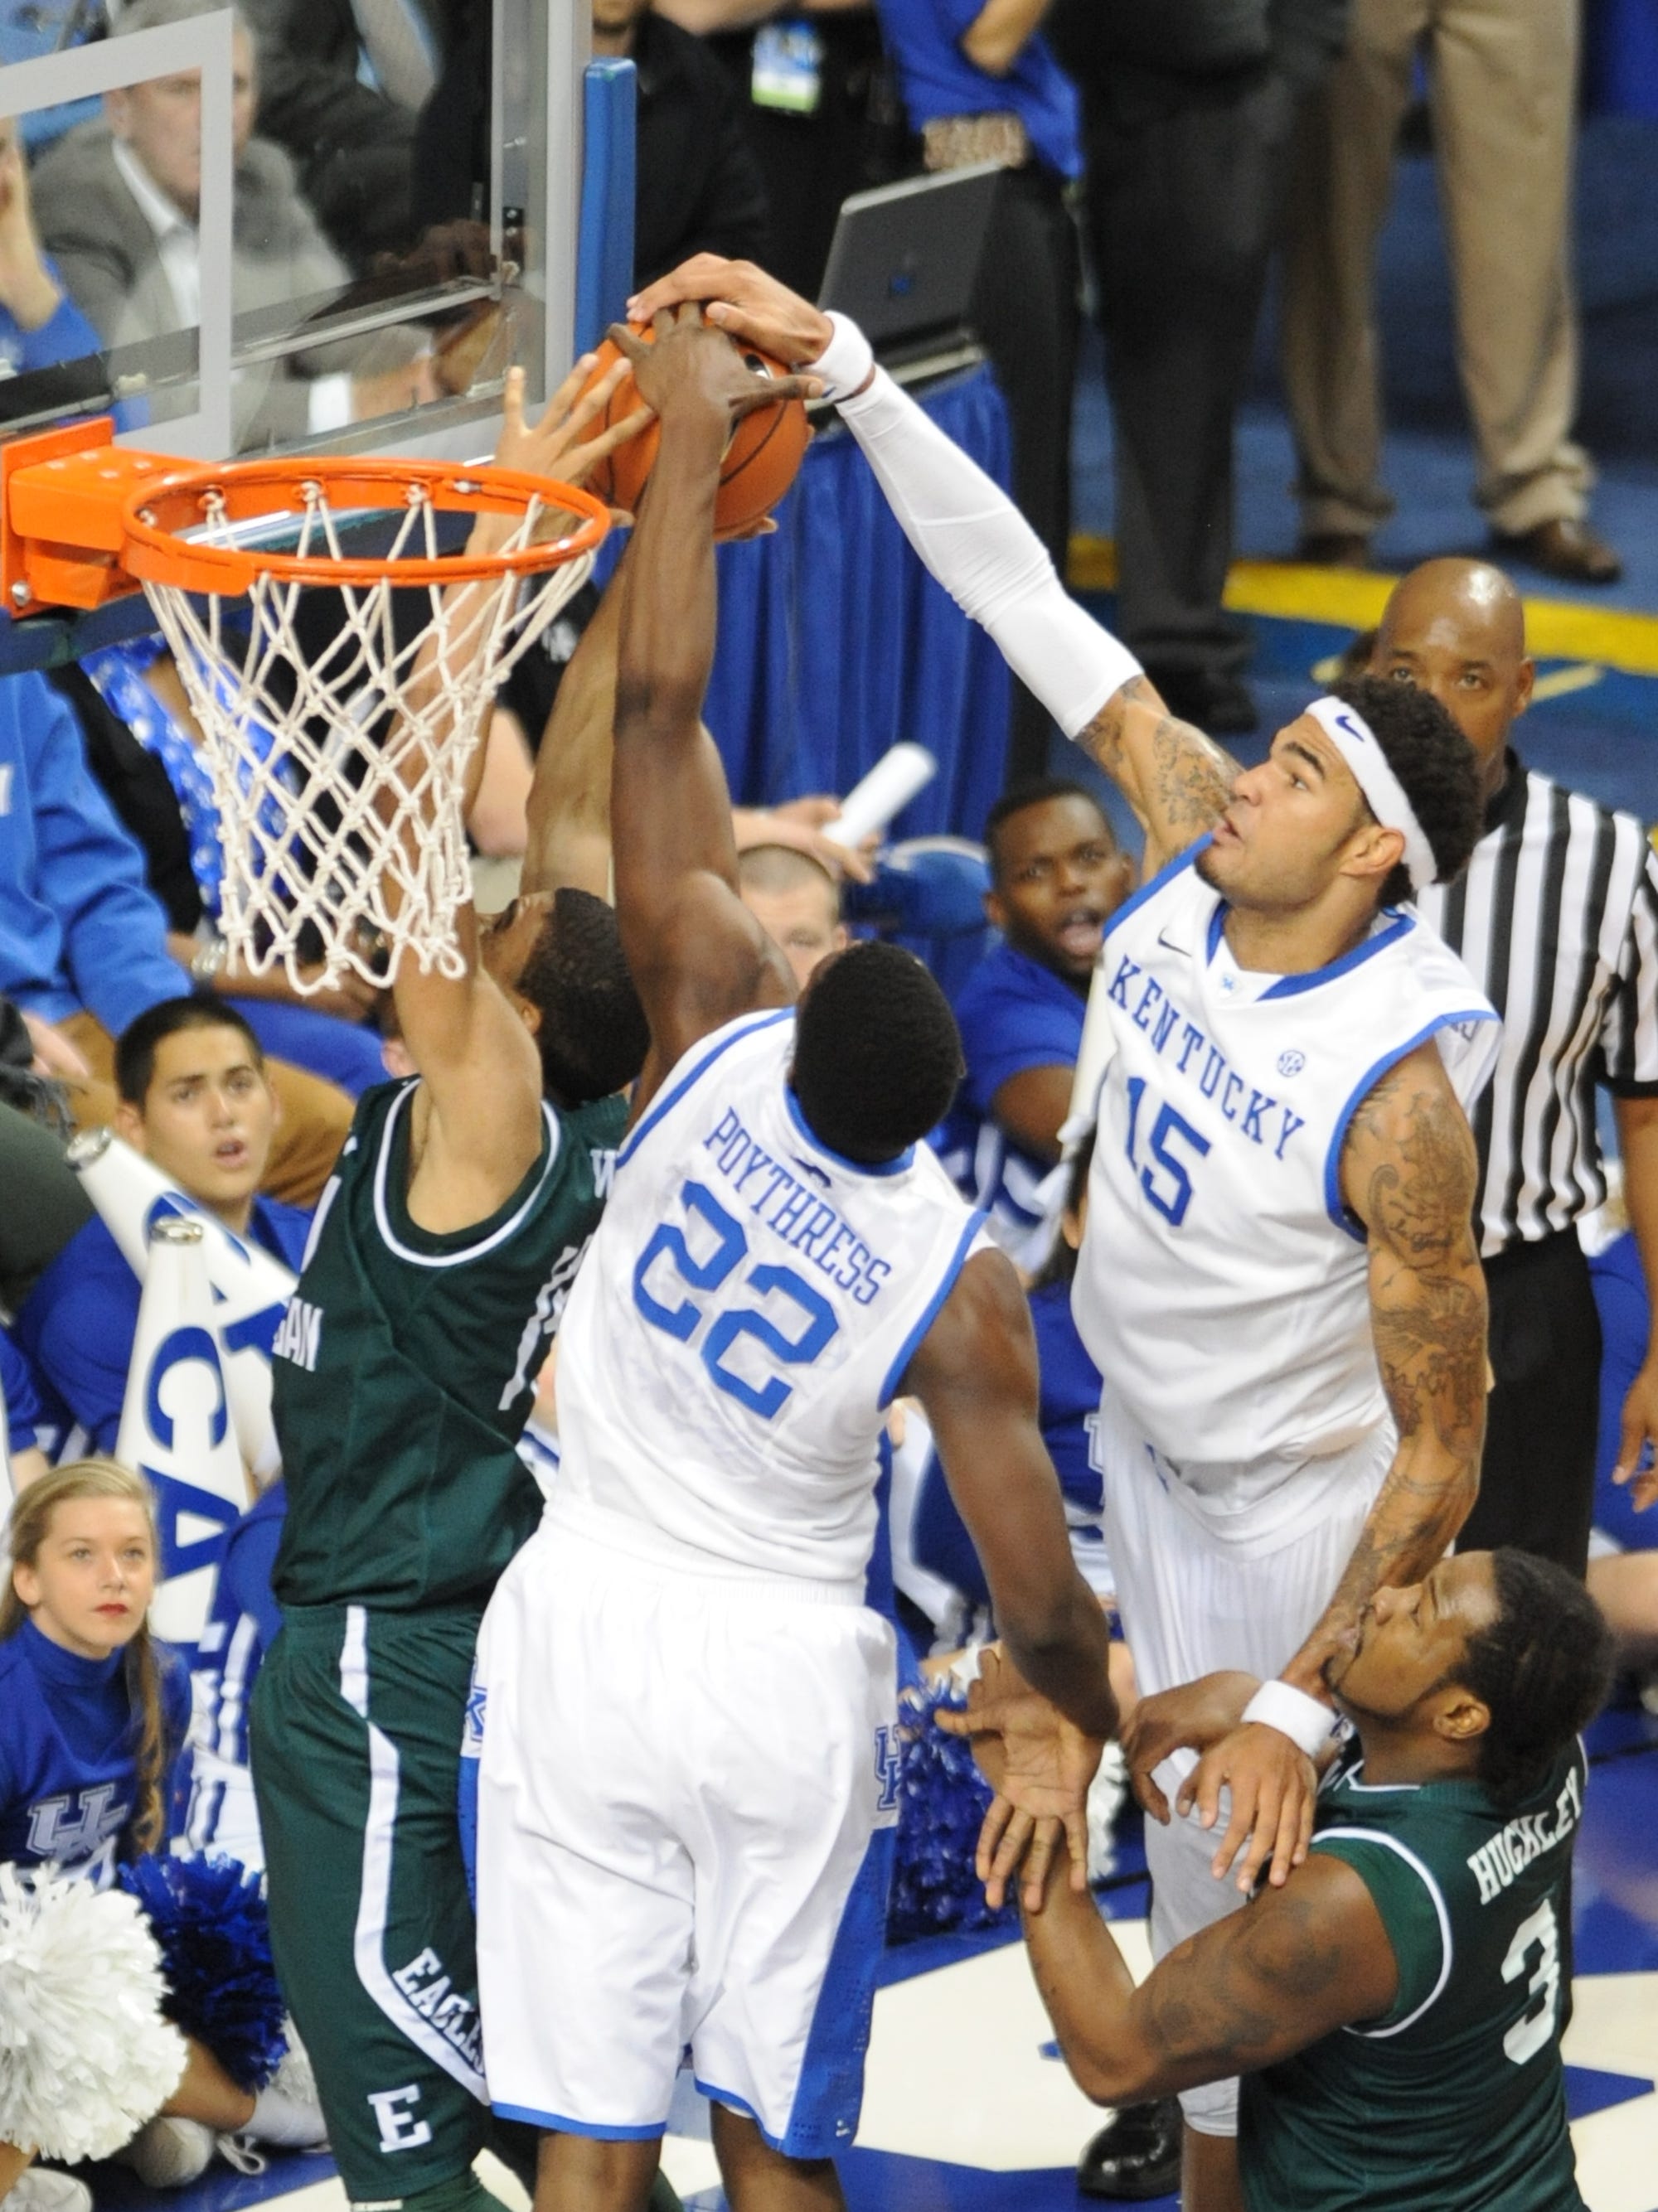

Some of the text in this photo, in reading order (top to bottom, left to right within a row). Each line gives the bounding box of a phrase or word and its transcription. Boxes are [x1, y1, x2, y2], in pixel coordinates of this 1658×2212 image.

[1108, 955, 1305, 1161] KENTUCKY
[703, 1106, 891, 1305] POYTHRESS
[1126, 1077, 1211, 1227] 15
[633, 1179, 840, 1421] 22
[1467, 1766, 1581, 1905] HUGHLEY
[1500, 1898, 1560, 2065] 3
[366, 2084, 432, 2153] E
